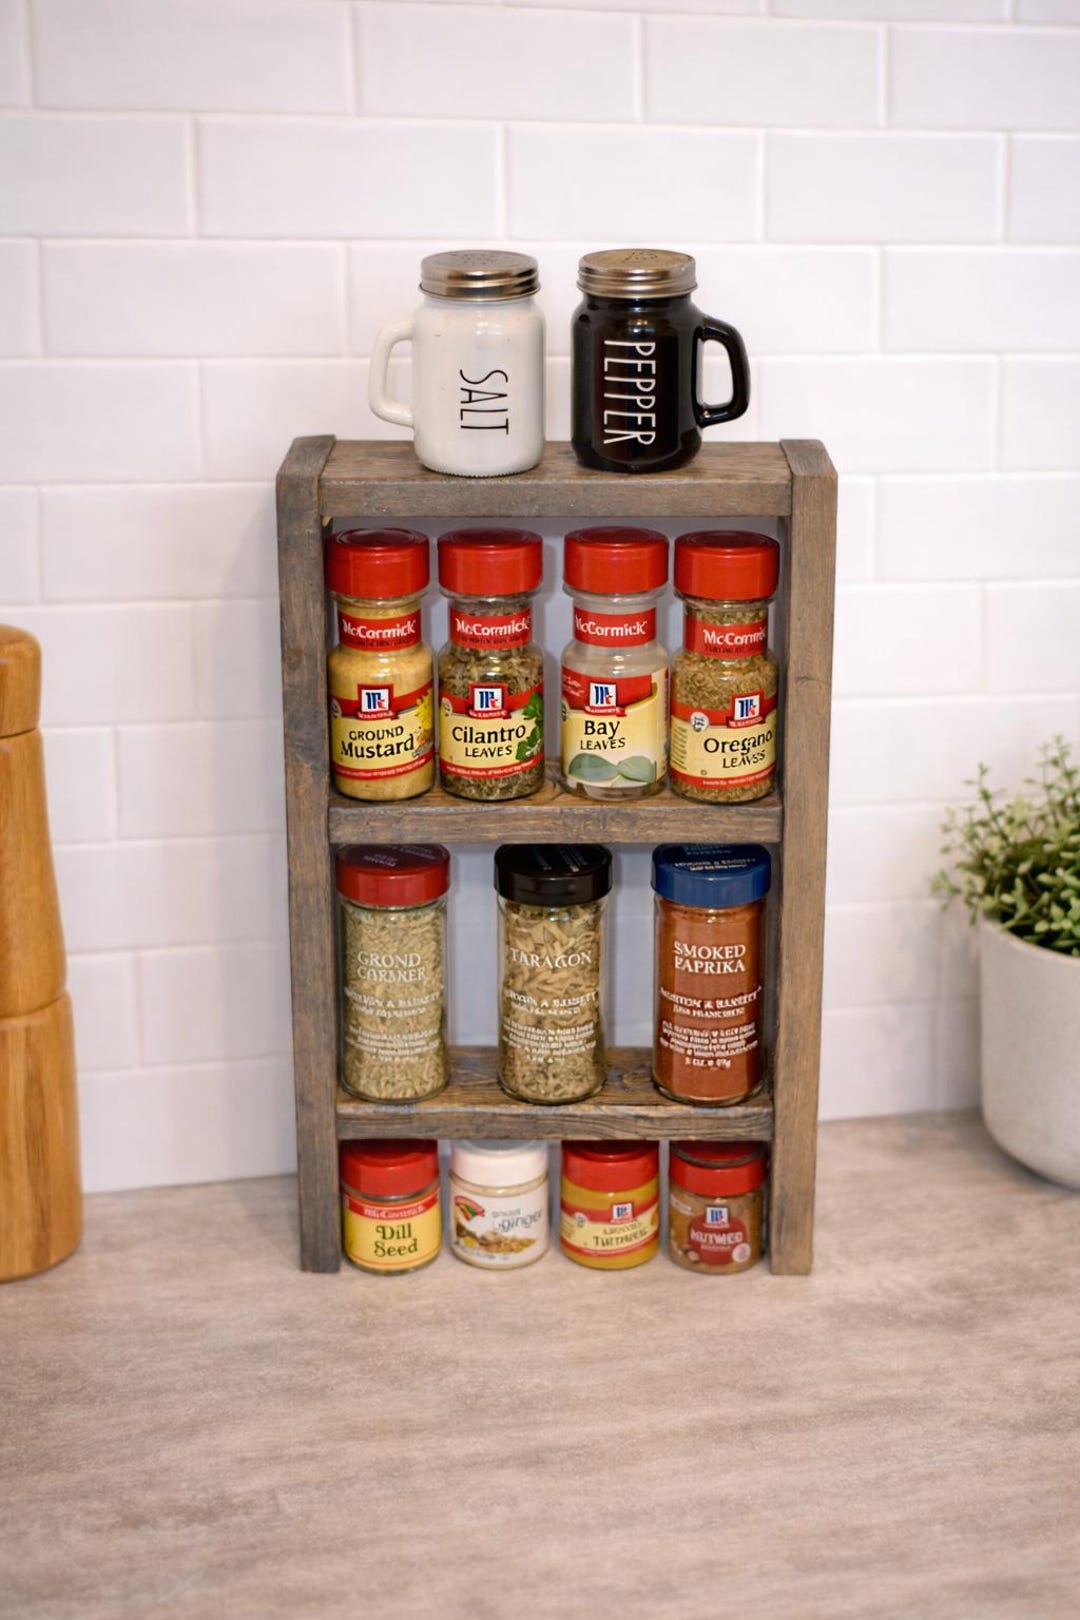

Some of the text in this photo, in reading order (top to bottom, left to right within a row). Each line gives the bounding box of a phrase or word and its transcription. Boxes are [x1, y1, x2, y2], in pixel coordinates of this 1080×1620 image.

[459, 369, 509, 435] SALT
[603, 340, 656, 445] PEPPER
[349, 725, 404, 741] GROUND
[452, 724, 526, 744] Cilantro
[584, 719, 620, 739] Bay
[341, 734, 415, 759] Mustard
[464, 746, 513, 758] LEAVES
[580, 737, 626, 751] LEAVES
[703, 730, 773, 755] Oregano
[673, 940, 747, 960] SMOKED
[674, 955, 746, 975] PAPRIKA
[375, 1222, 412, 1241] Dill
[373, 1239, 419, 1257] Seed
